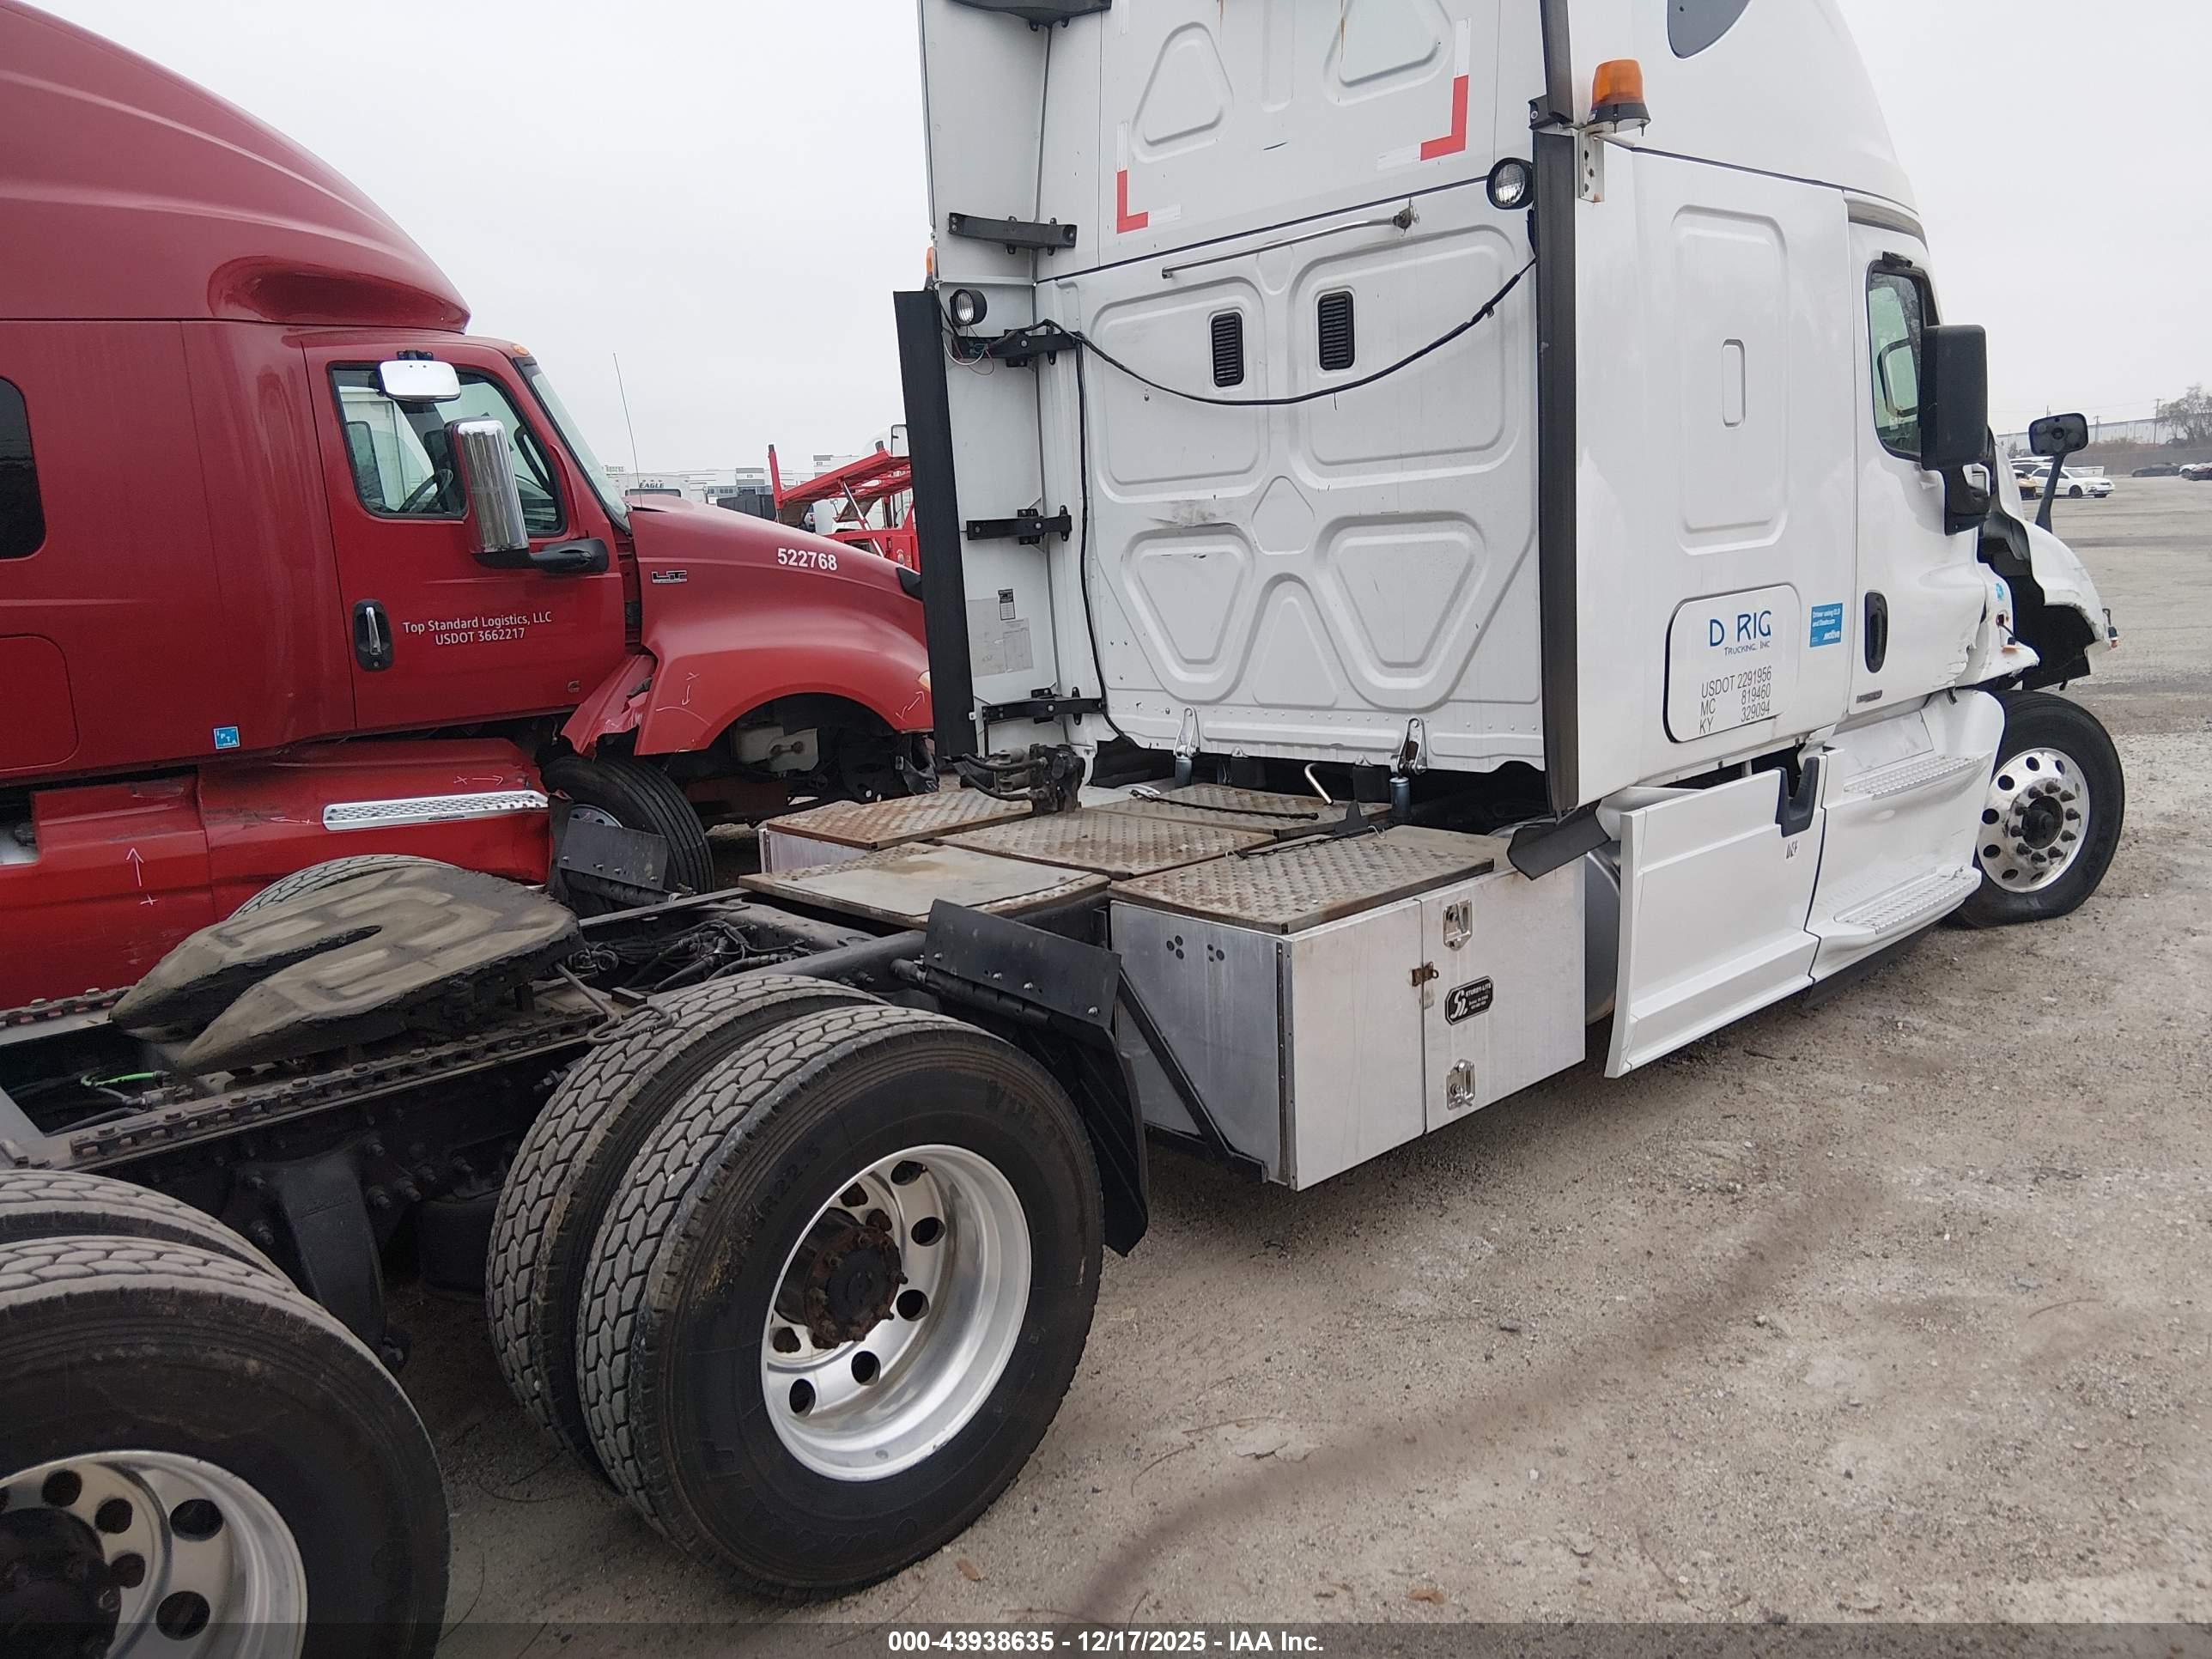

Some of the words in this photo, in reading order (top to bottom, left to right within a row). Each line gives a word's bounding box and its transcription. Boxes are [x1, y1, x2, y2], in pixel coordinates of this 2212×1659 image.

[777, 547, 838, 571] 522768
[404, 622, 425, 635] Top
[428, 617, 478, 632] Standard
[482, 614, 531, 628] Logistics,
[533, 611, 552, 623] LLC
[435, 631, 474, 645] USDOT
[477, 628, 526, 642] 3662217
[1709, 618, 1725, 647] D
[1737, 610, 1771, 642] RIG
[1759, 640, 1771, 650] INC
[1701, 675, 1735, 698] USDOT
[1737, 665, 1771, 689] 2291956
[1700, 698, 1717, 716] MC
[1741, 684, 1771, 705] 819460
[1699, 717, 1714, 735] KY
[1741, 701, 1771, 722] 329094
